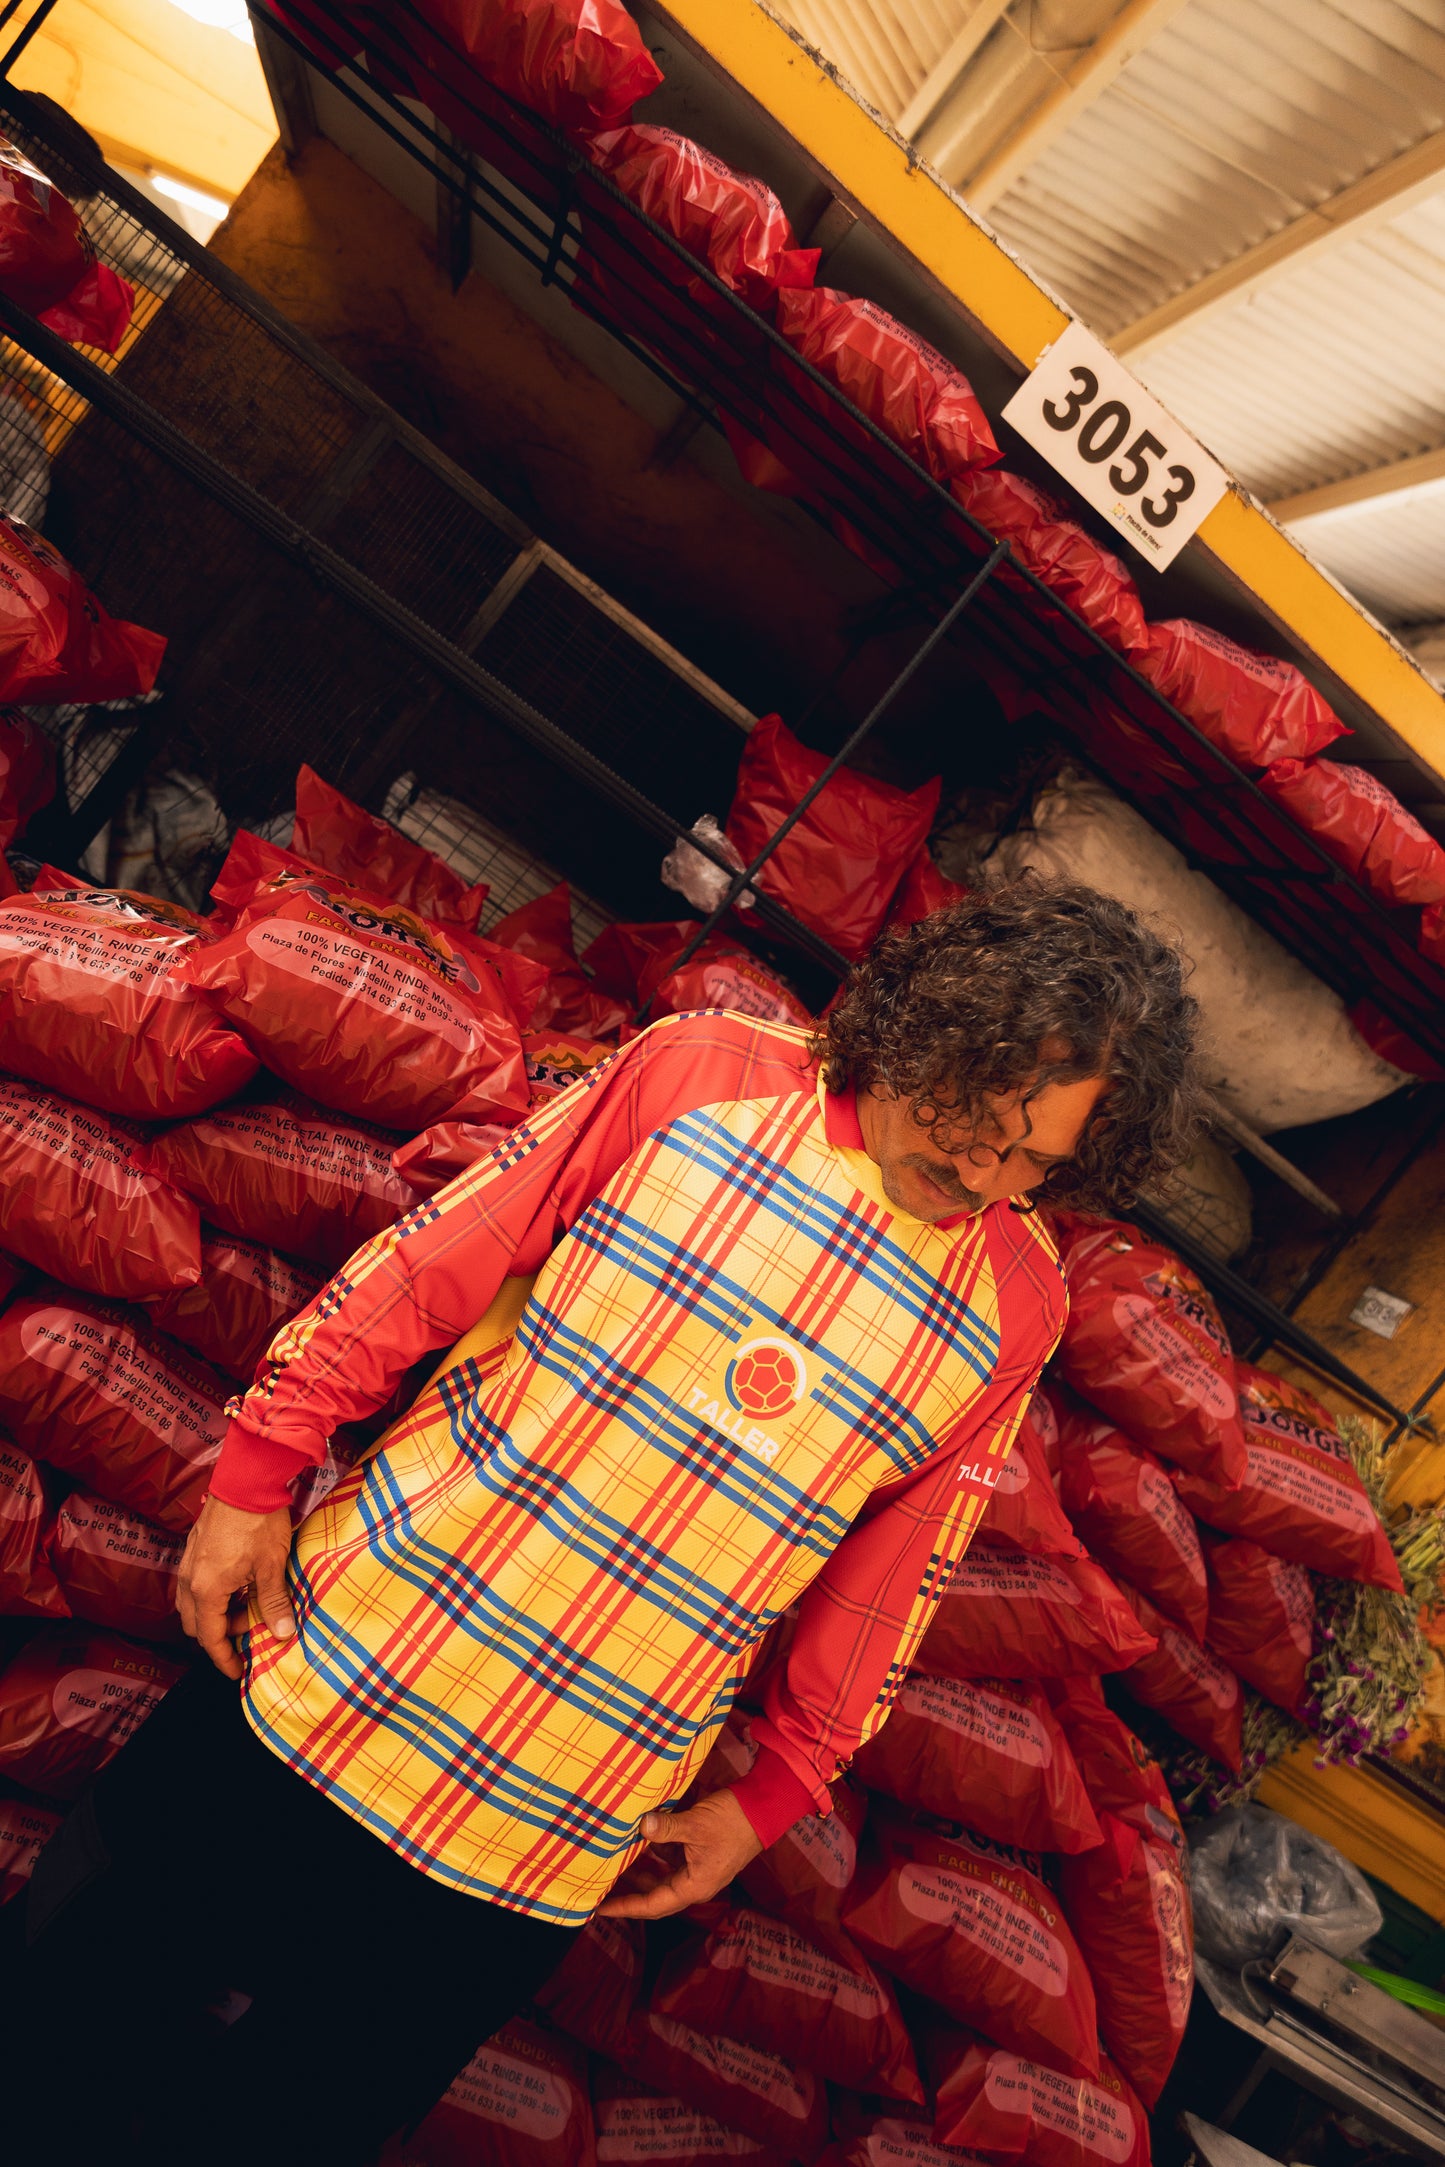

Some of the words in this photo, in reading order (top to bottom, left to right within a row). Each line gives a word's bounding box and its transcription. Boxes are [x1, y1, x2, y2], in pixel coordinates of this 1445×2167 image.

[1042, 366, 1196, 528] 3053
[5, 913, 38, 927] 100%
[43, 919, 105, 944] VEGETAL
[108, 938, 153, 957] RINDE
[16, 924, 51, 939] Flores
[111, 952, 143, 968] Local
[129, 969, 144, 984] 08
[261, 932, 293, 949] Plaza
[295, 943, 309, 955] de
[310, 948, 345, 970] Flores
[396, 987, 425, 1006] Local
[296, 930, 330, 951] 100%
[334, 942, 390, 976] VEGETAL
[393, 968, 429, 996] RINDE
[310, 964, 357, 991] Pedidos:
[359, 982, 377, 999] 314
[378, 993, 398, 1009] 633
[399, 1003, 413, 1015] 84
[414, 1008, 427, 1021] 08
[10, 1090, 68, 1120] VEGETAL
[28, 1127, 49, 1143] 314
[70, 1149, 84, 1163] 84
[71, 1132, 99, 1156] Local
[237, 1121, 252, 1132] de
[253, 1124, 286, 1145] Flores
[337, 1149, 364, 1167] Local
[240, 1109, 272, 1124] 100%
[275, 1117, 329, 1142] VEGETAL
[332, 1133, 371, 1154] RINDE
[253, 1140, 299, 1164] Pedidos:
[299, 1154, 317, 1168] 314
[318, 1160, 338, 1174] 633
[339, 1167, 351, 1178] 84
[353, 1173, 365, 1183] 08
[36, 1325, 67, 1344] Plaza
[68, 1338, 83, 1350] de
[150, 1389, 178, 1414] Local
[73, 1321, 105, 1345] 100%
[152, 1370, 187, 1402] RINDE
[187, 1396, 212, 1423] MÁS
[110, 1382, 129, 1399] 314
[129, 1393, 148, 1412] 633
[146, 1406, 161, 1421] 84
[158, 1416, 173, 1431] 08
[688, 1386, 779, 1463] TALLER
[1249, 1410, 1351, 1465] JORGE
[0, 1452, 28, 1475] MÁS
[93, 1504, 125, 1521] 100%
[91, 1518, 104, 1530] de
[106, 1523, 139, 1540] Flores
[105, 1538, 152, 1559] Pedidos:
[980, 1577, 996, 1588] 314
[68, 1691, 98, 1709] Plaza
[99, 1700, 113, 1713] de
[102, 1682, 133, 1702] 100%
[906, 1681, 917, 1691] de
[918, 1682, 945, 1702] Flores
[932, 1673, 977, 1702] VEGETAL
[969, 1720, 986, 1736] 633
[995, 1734, 1008, 1747] 08
[911, 1879, 937, 1898] Plaza
[937, 1891, 950, 1902] de
[936, 1875, 963, 1894] 100%
[964, 1885, 1003, 1918] VEGETAL
[938, 1853, 982, 1876] FACIL
[990, 1870, 1056, 1927] ENCENDIDO
[761, 1926, 809, 1953] VEGETAL
[783, 1968, 800, 1982] 314
[460, 2088, 476, 2102] 314
[1017, 2081, 1028, 2091] de
[1040, 2070, 1077, 2100] VEGETAL
[643, 2106, 689, 2121] VEGETAL
[880, 2139, 903, 2156] Plaza
[905, 2147, 915, 2159] de
[903, 2128, 929, 2147] 100%
